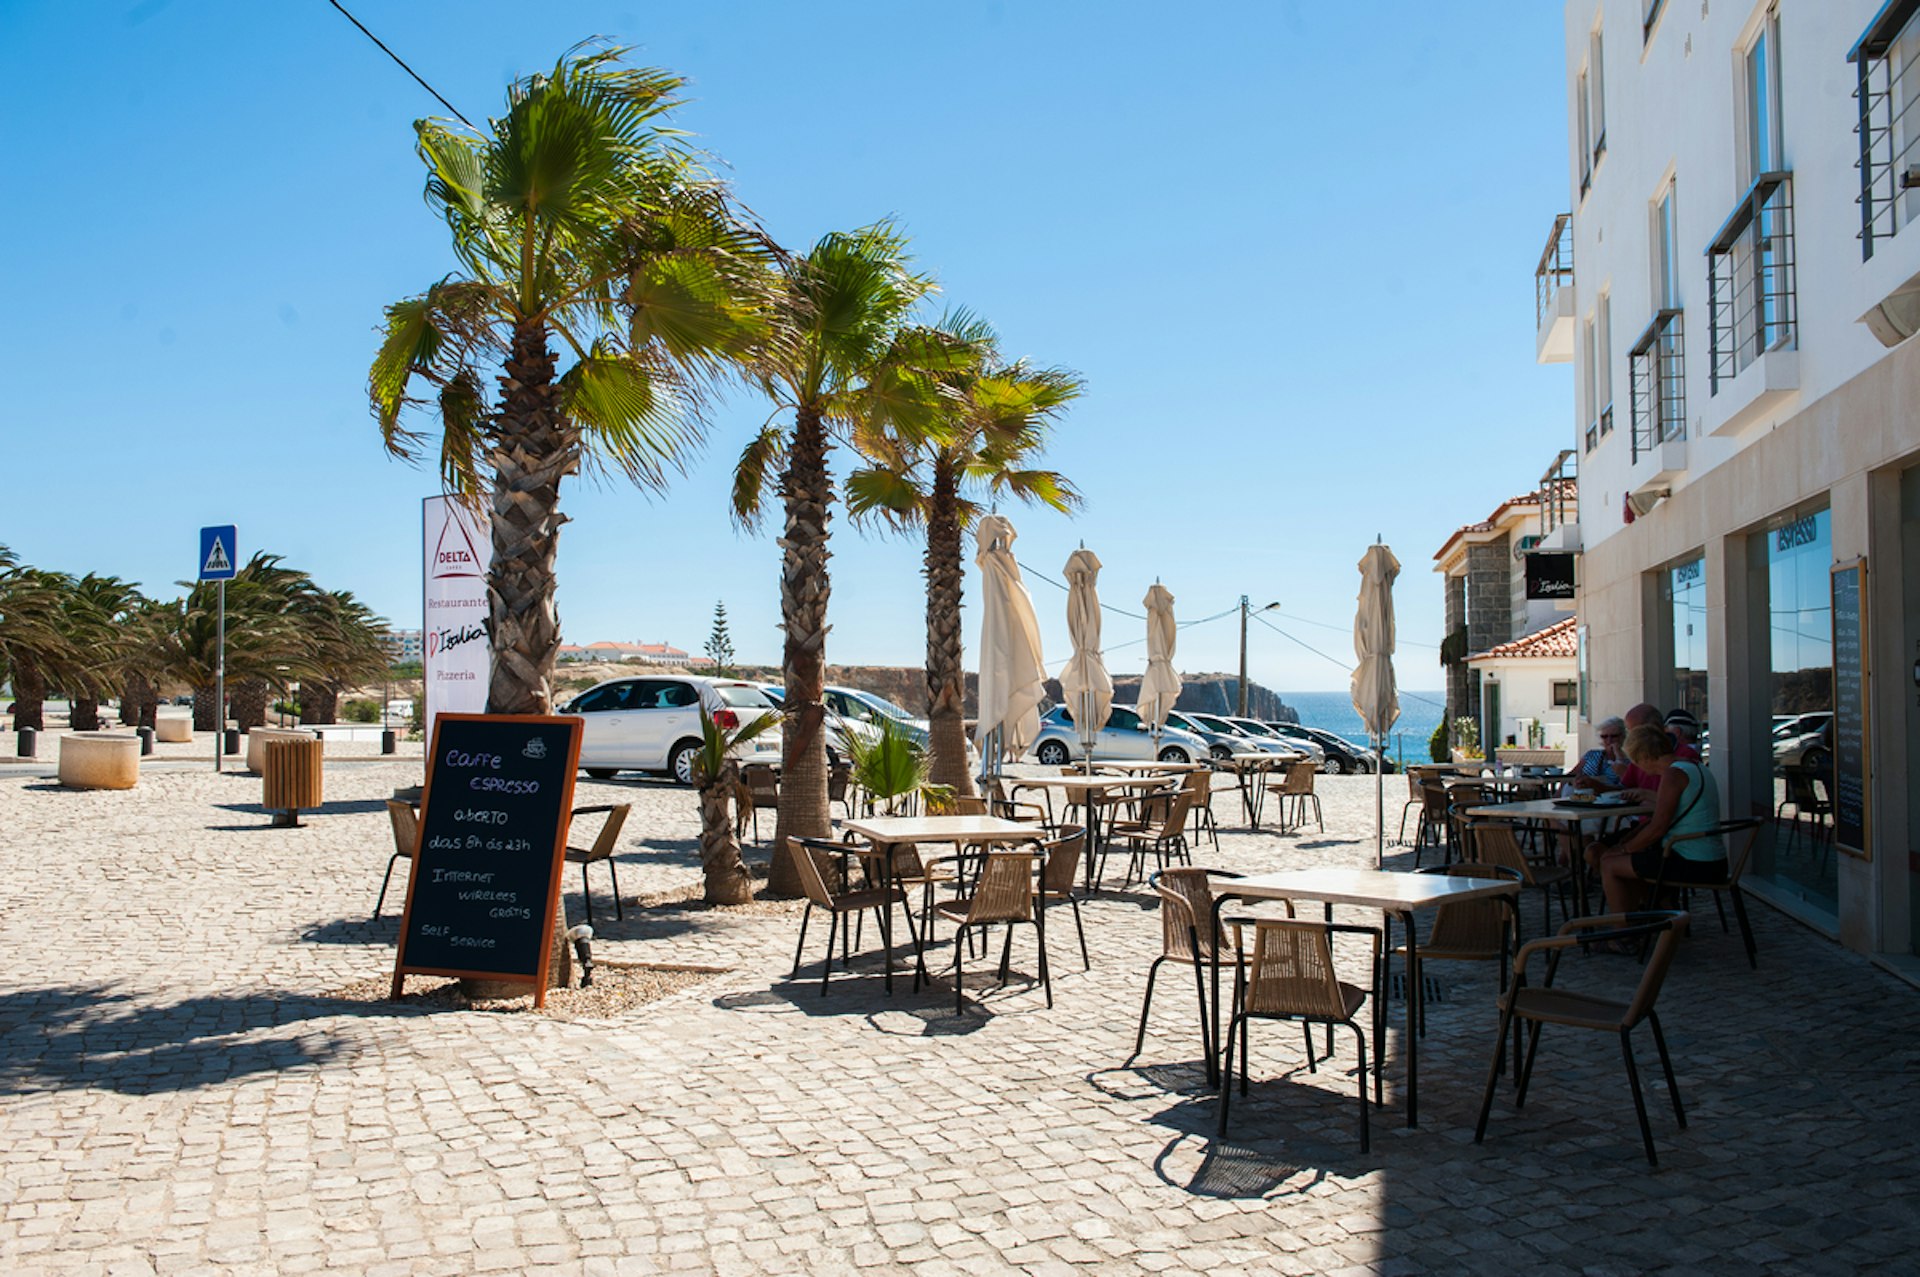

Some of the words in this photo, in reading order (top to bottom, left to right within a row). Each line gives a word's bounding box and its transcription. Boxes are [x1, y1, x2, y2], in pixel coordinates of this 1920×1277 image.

[439, 551, 471, 563] DELTA
[428, 598, 489, 609] Restaurante
[437, 668, 476, 681] Pizzeria
[428, 835, 462, 849] das
[504, 839, 531, 851] 23h
